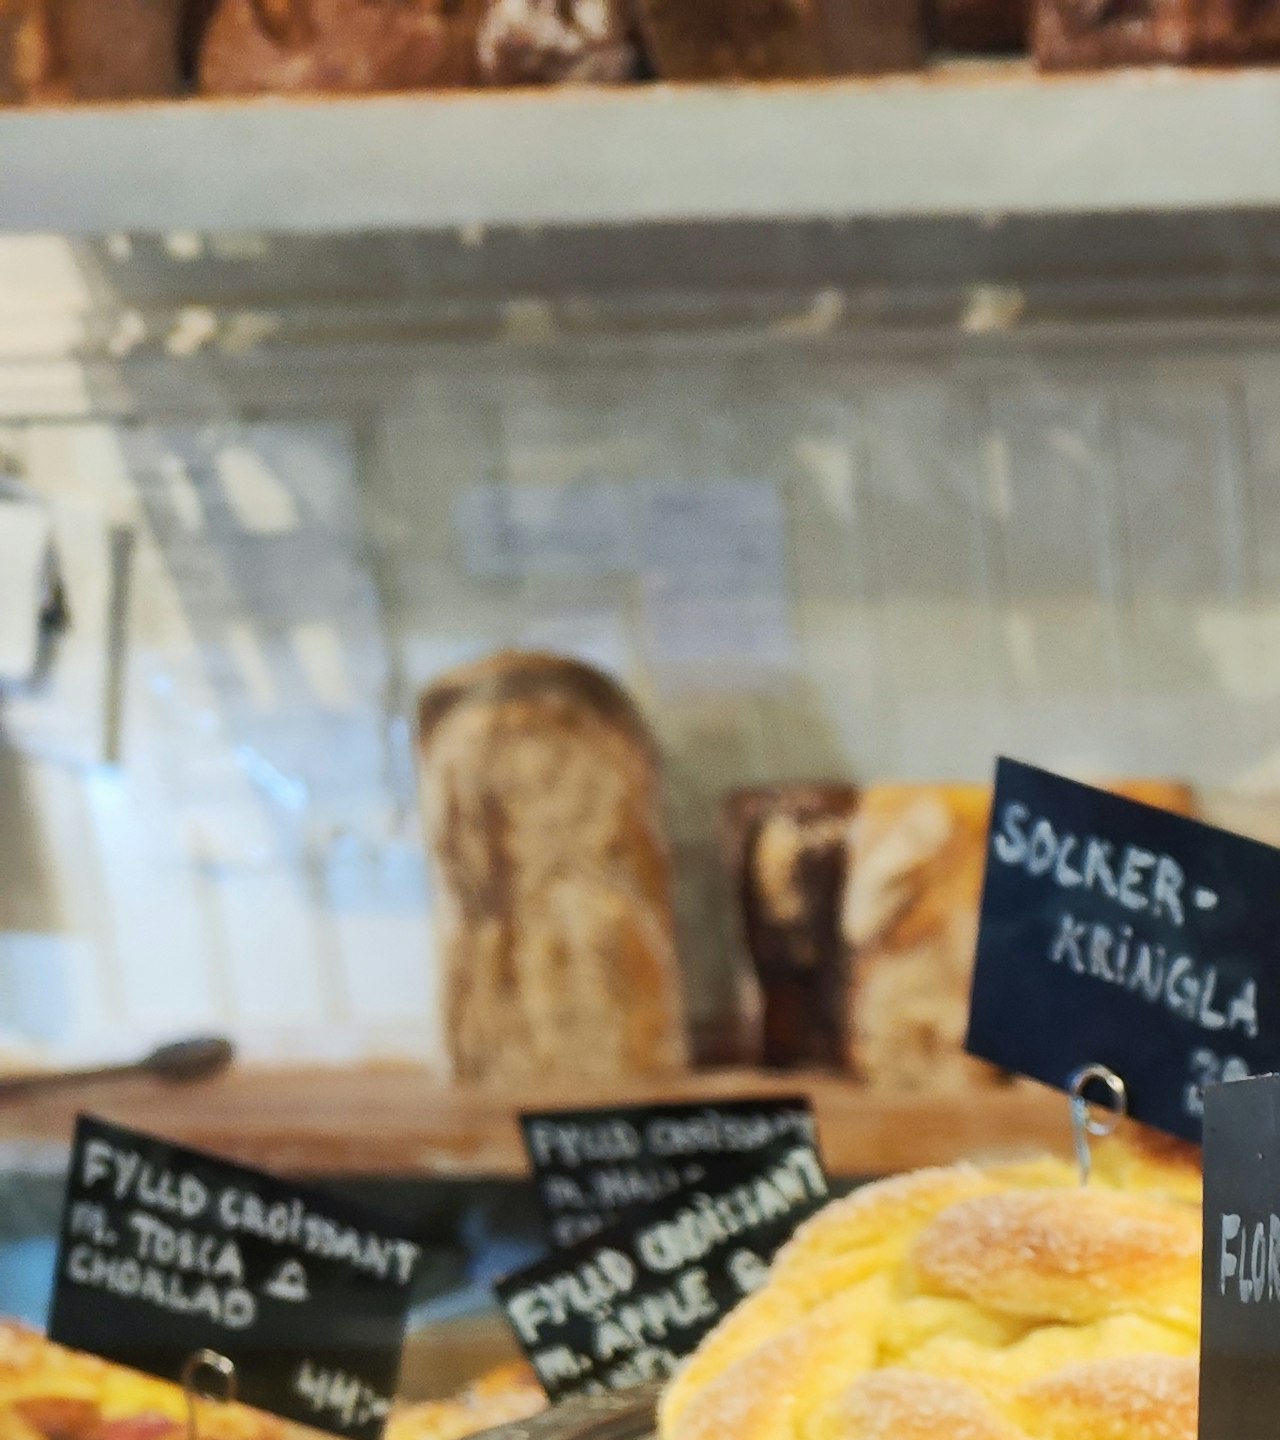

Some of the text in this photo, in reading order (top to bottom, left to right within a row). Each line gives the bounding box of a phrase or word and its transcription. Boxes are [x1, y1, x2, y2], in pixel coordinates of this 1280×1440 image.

[992, 802, 1219, 927] SOCKER-
[83, 1137, 208, 1217] FYLLD
[127, 1209, 246, 1288] TOSCA
